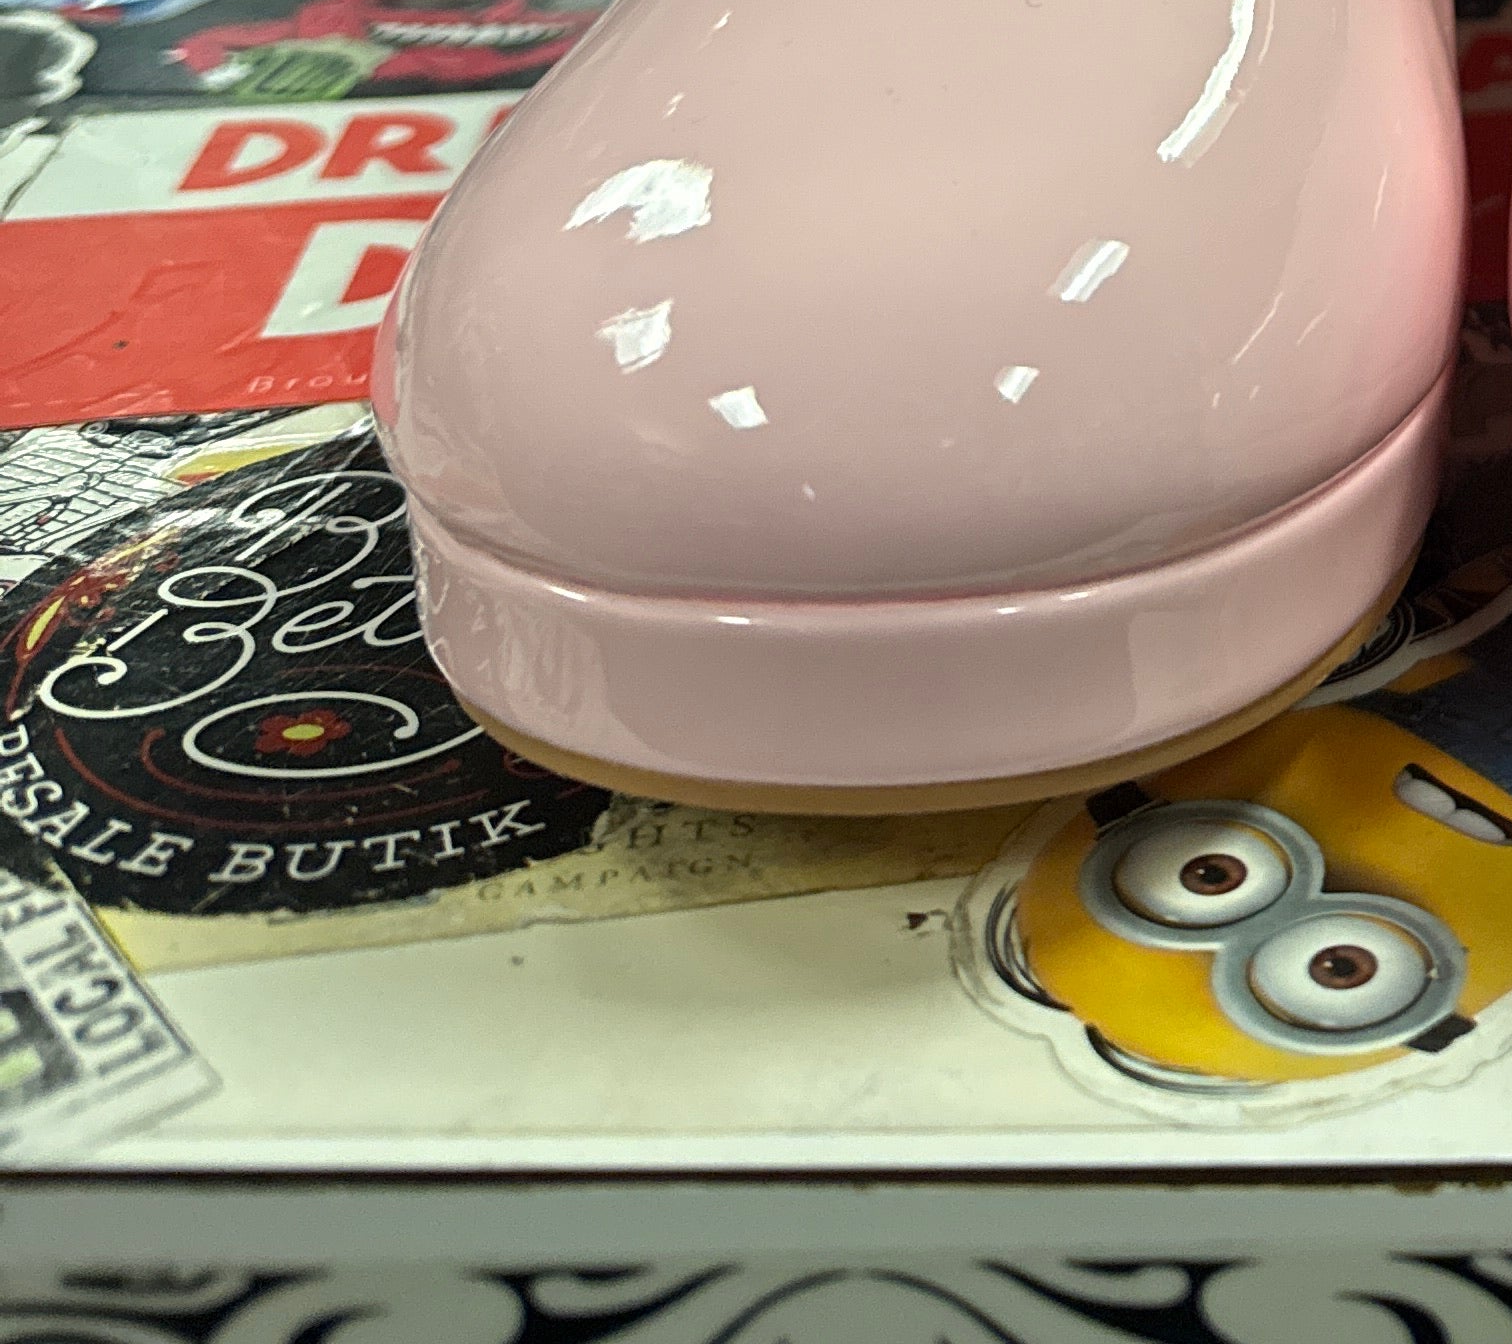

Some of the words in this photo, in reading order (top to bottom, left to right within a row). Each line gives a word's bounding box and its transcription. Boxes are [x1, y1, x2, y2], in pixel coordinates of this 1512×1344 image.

[176, 107, 512, 194] DR
[208, 799, 547, 883] BUTIK
[24, 918, 167, 1076] LOCAL
